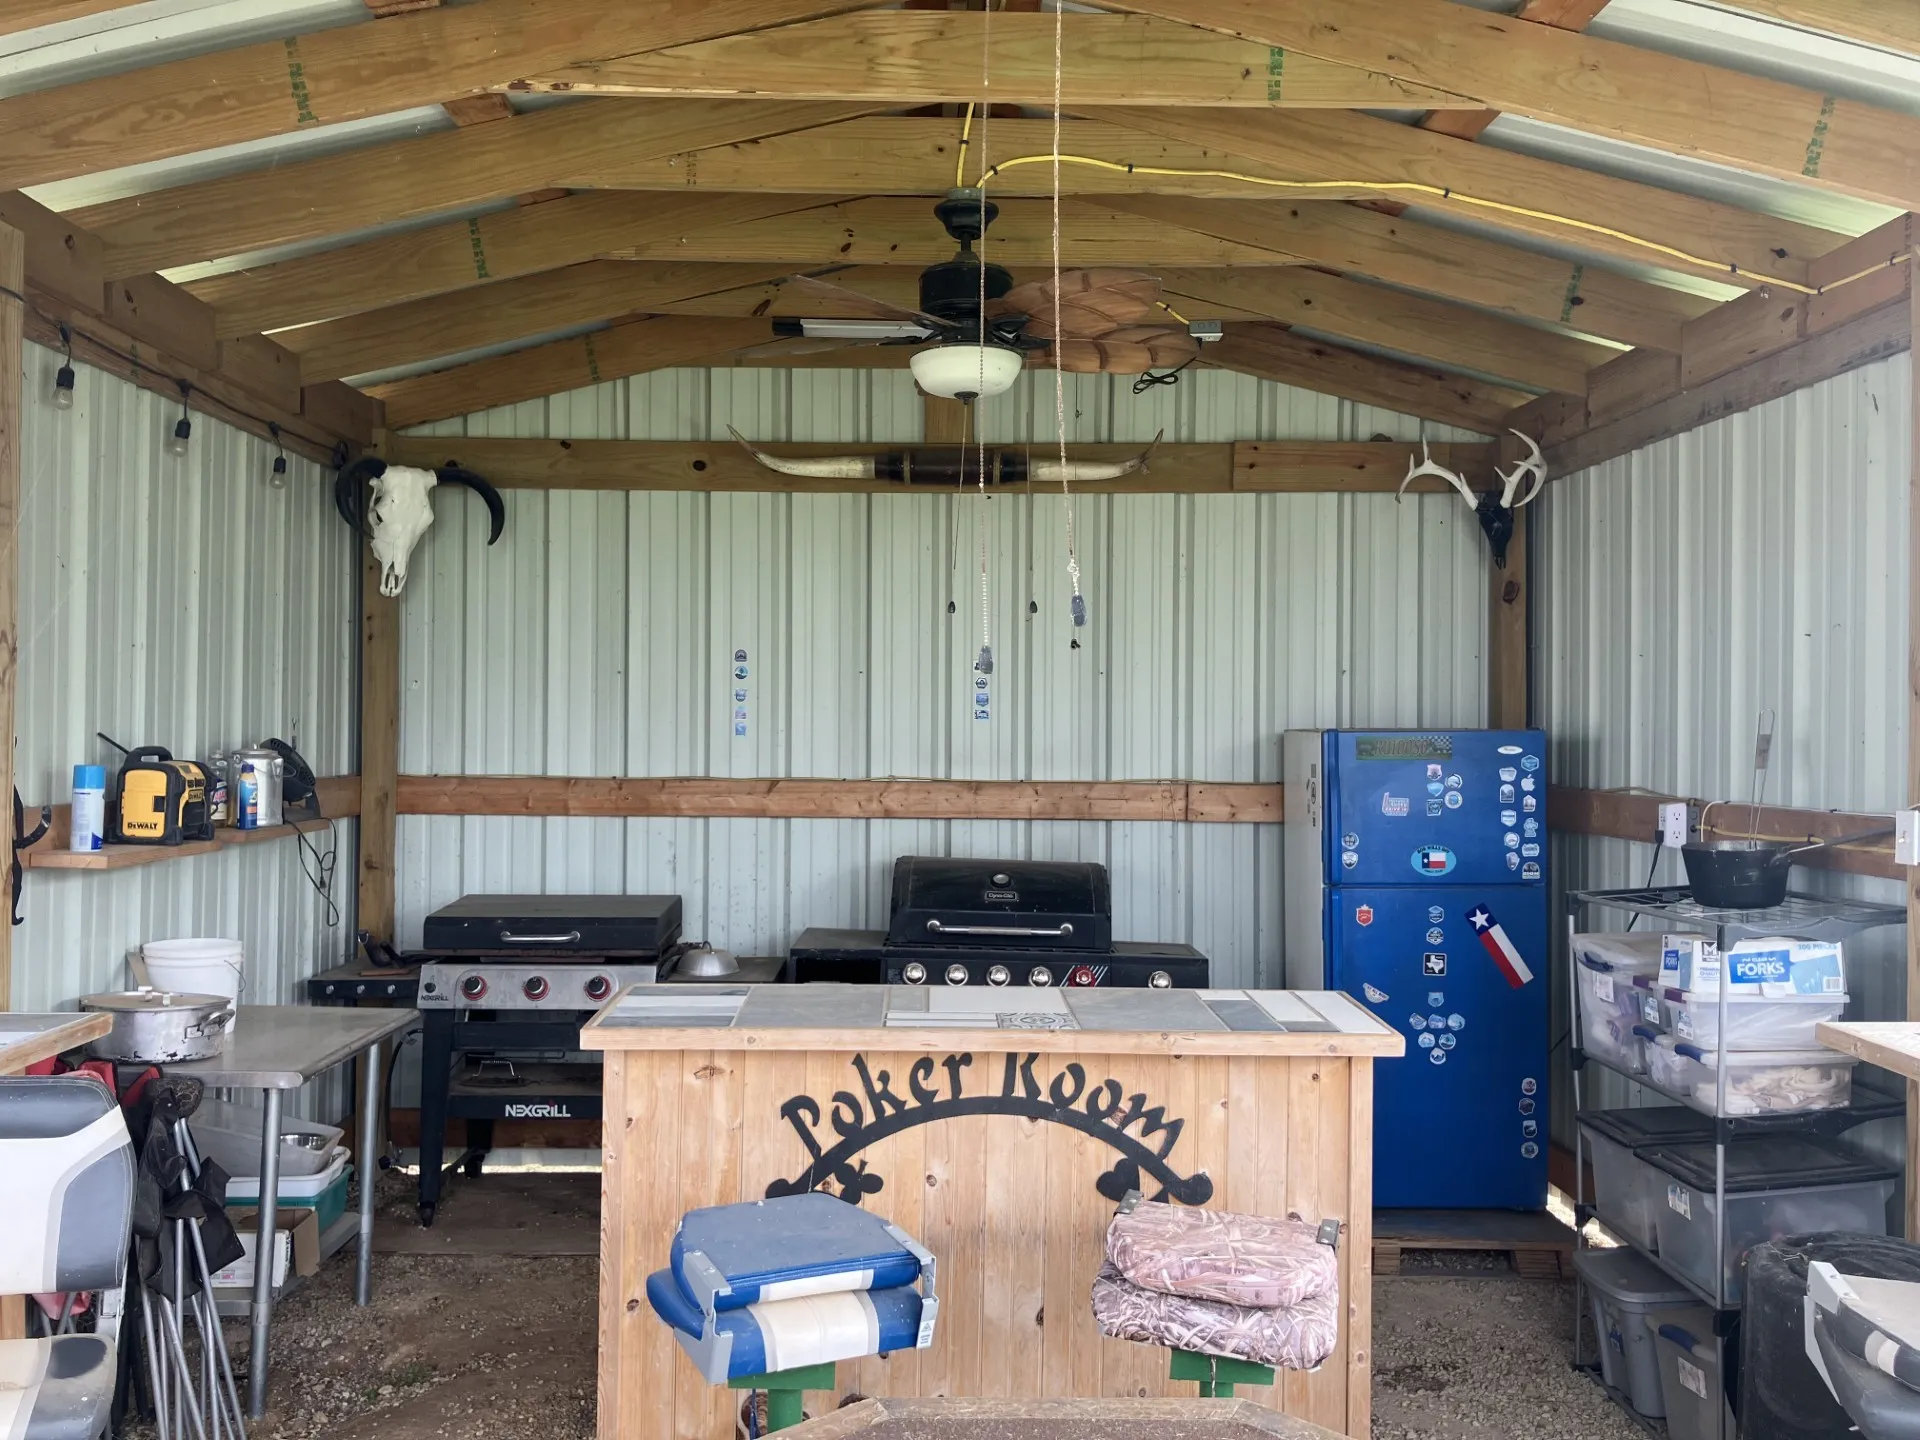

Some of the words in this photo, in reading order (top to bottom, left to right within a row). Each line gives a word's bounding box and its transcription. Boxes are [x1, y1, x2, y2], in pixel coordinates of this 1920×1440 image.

[1736, 961, 1785, 976] FORKS
[505, 1103, 571, 1117] NEXGRILL
[781, 1052, 973, 1159] Poker
[1001, 1052, 1185, 1159] Room
